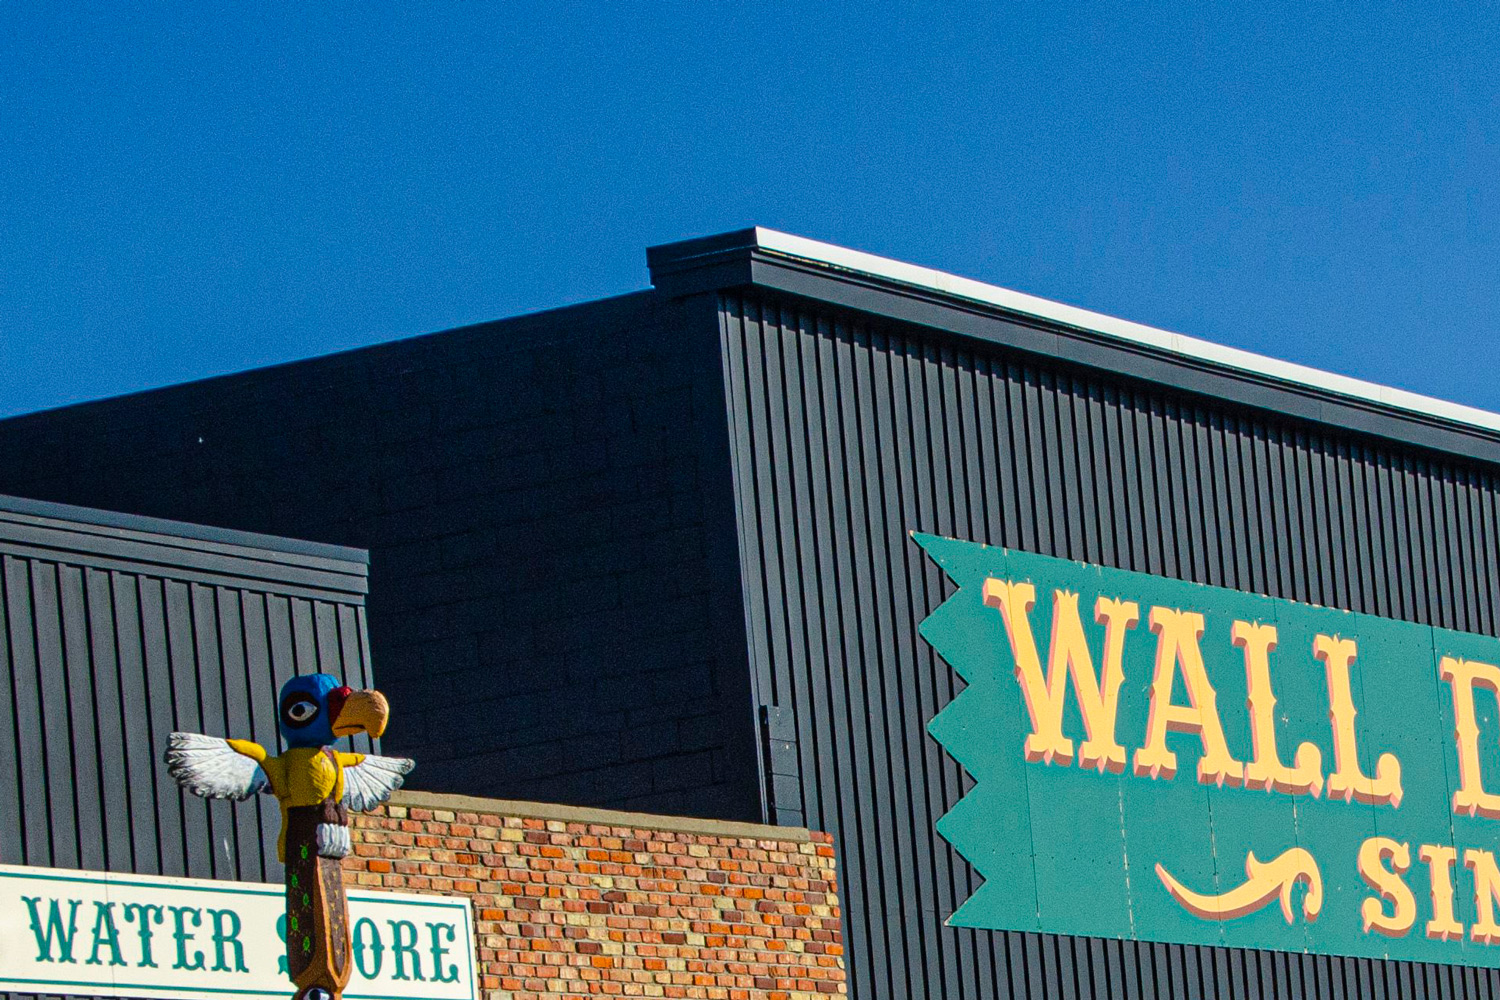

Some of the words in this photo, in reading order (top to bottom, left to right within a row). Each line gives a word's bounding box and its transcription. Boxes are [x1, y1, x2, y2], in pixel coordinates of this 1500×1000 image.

[982, 577, 1403, 809] WALL
[21, 896, 249, 973] WATER
[276, 913, 460, 984] ORE
